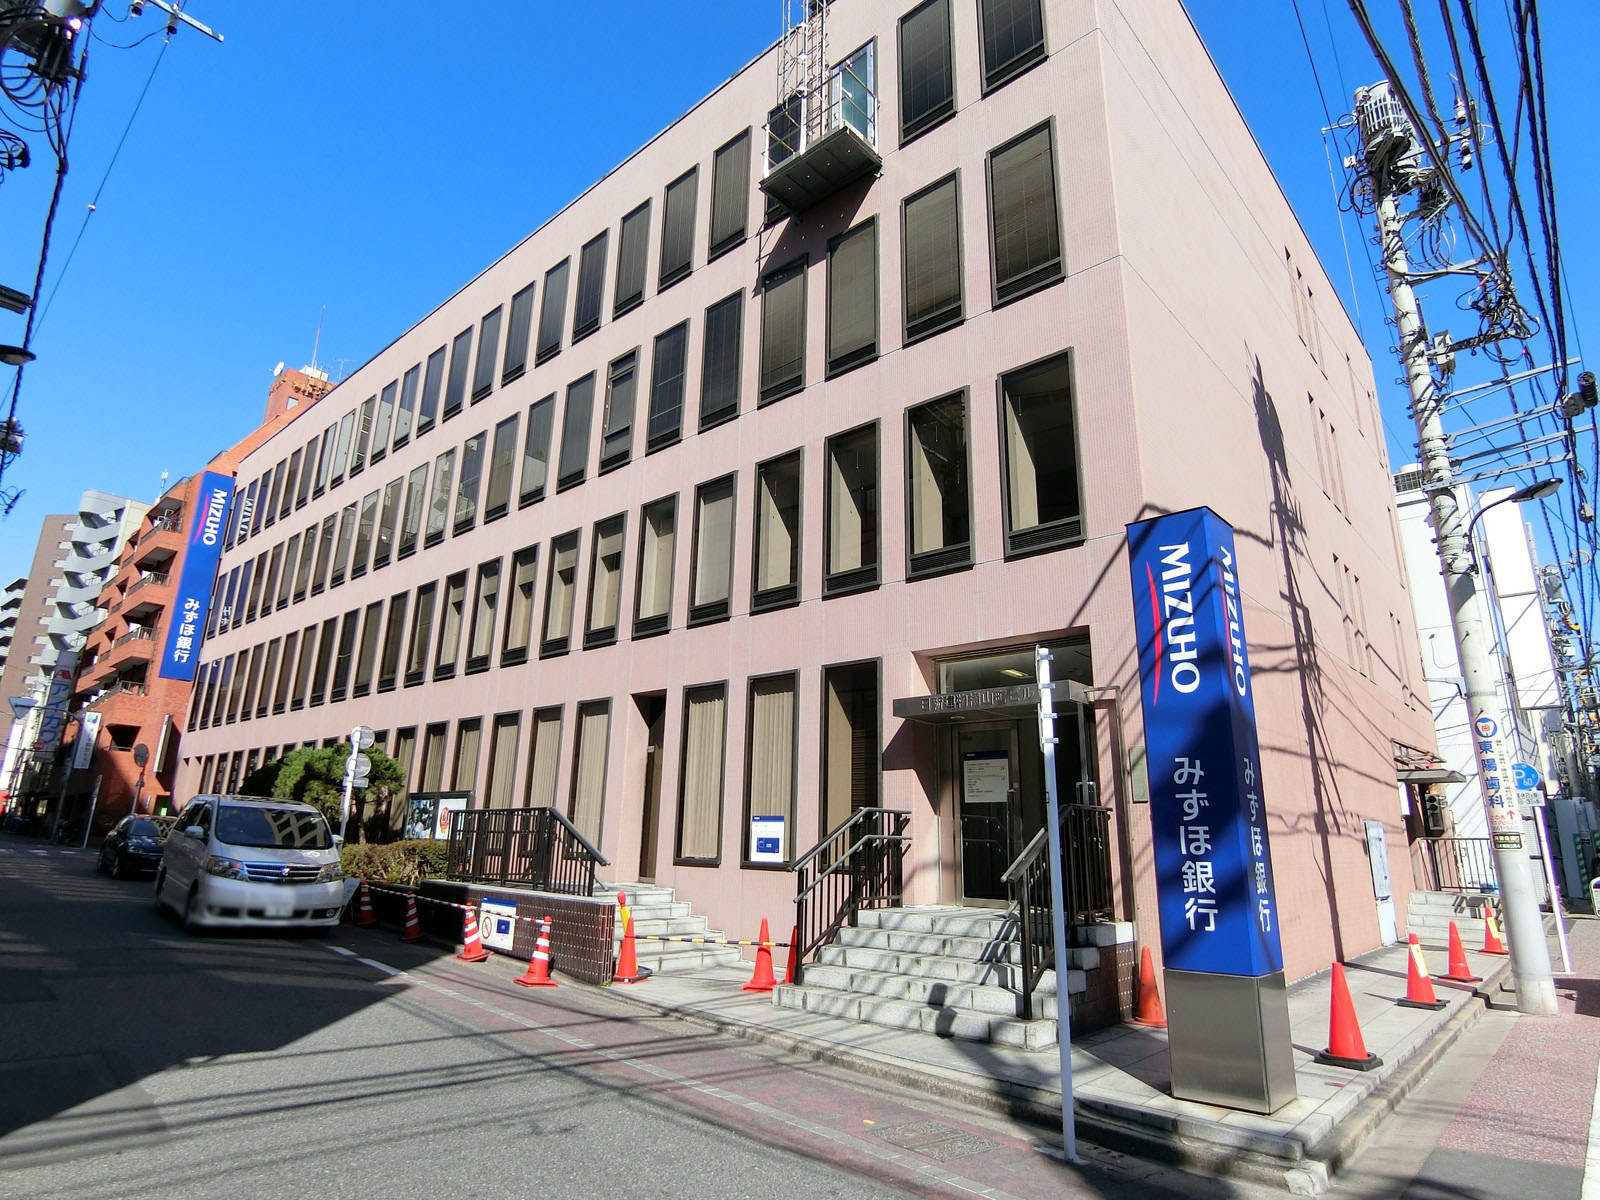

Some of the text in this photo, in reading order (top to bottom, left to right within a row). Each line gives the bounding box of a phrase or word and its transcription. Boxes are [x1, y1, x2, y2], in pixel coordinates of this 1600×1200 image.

[203, 488, 227, 546] MIZUHO
[174, 598, 200, 663] みずほ銀行
[1159, 541, 1200, 694] MIZUHO
[1220, 545, 1246, 697] MIZUHO
[1479, 741, 1504, 808] 東陽歯科
[1513, 769, 1526, 787] P
[1173, 757, 1218, 932] みずほ銀行
[1244, 757, 1271, 932] みずほ銀行
